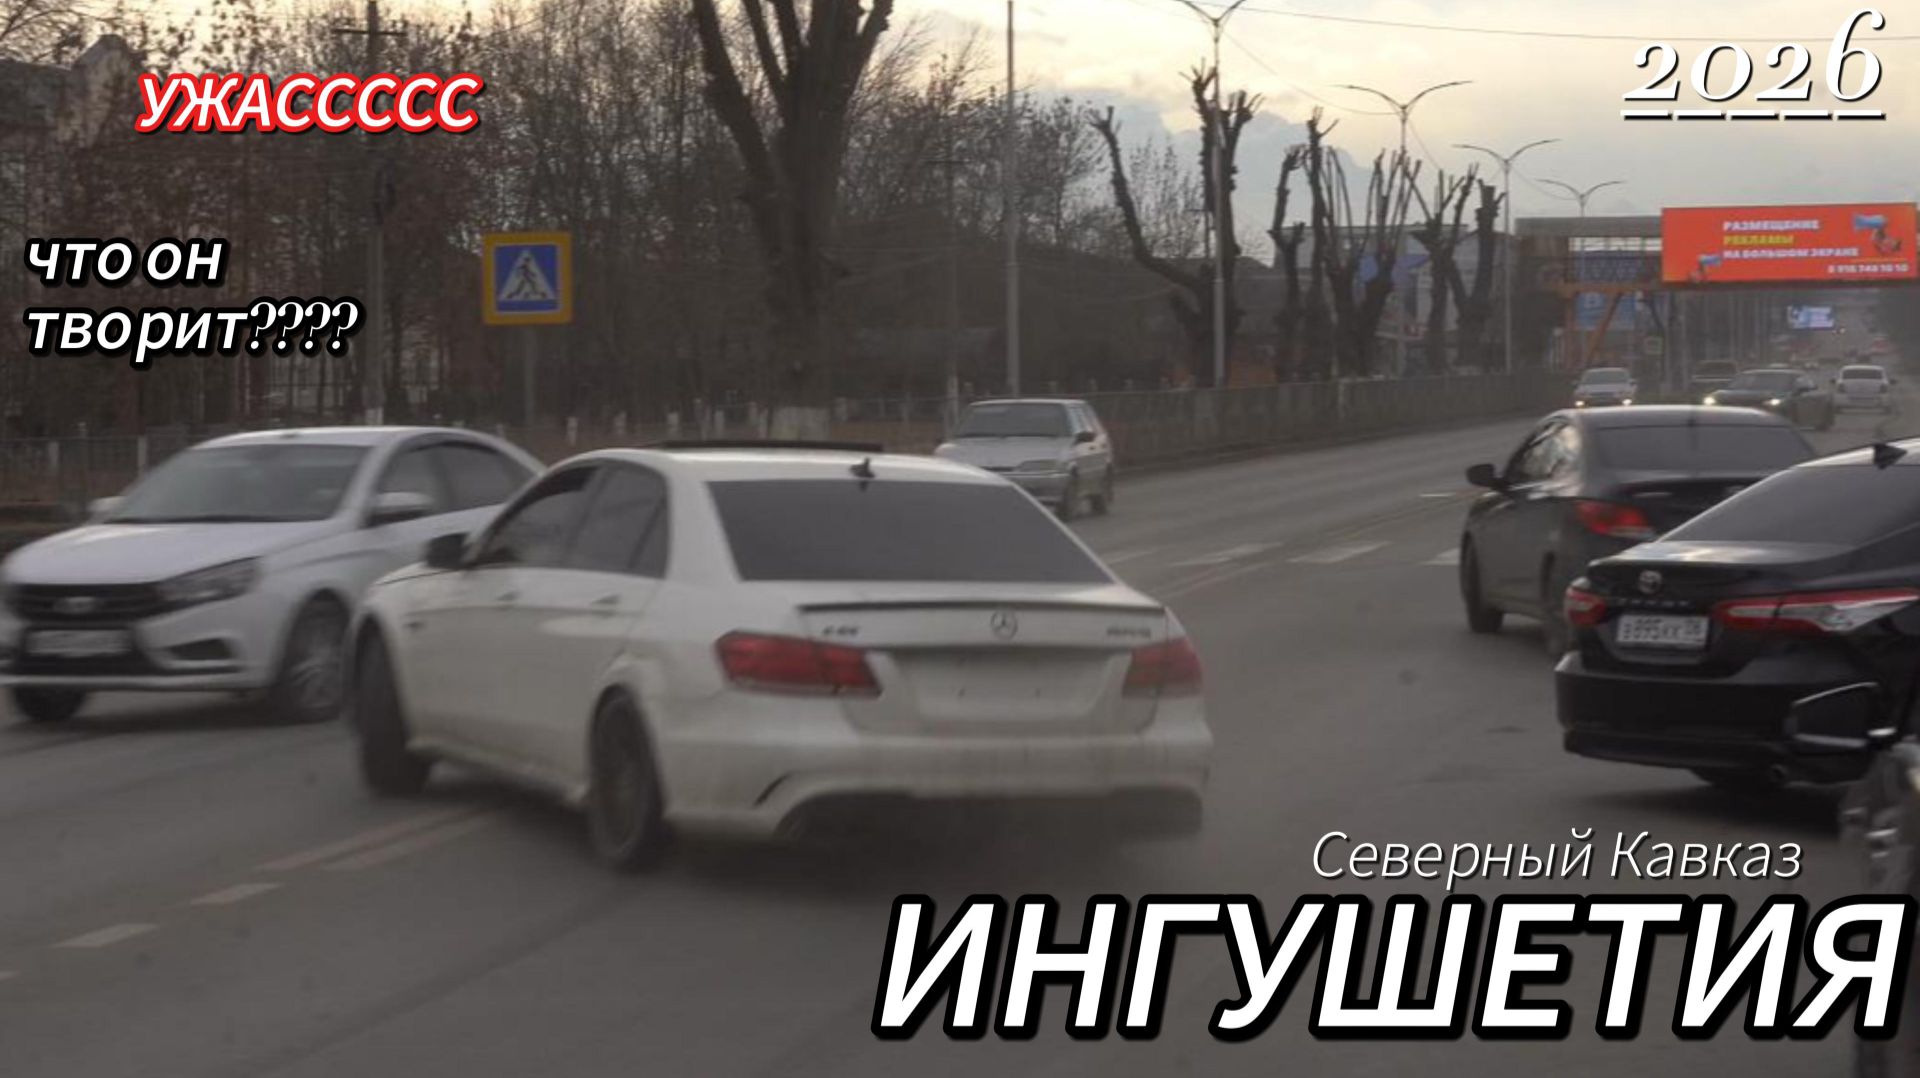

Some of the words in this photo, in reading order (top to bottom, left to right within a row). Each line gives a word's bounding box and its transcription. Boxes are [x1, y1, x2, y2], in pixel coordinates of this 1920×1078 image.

[1723, 219, 1819, 231] РАЗМЕЩЕНИЕ
[1723, 235, 1794, 246] РЕКЛАМЫ
[1723, 249, 1741, 259] НА
[1742, 248, 1808, 258] БОЛЬШОМ
[1810, 247, 1859, 257] ЭКРАНЕ
